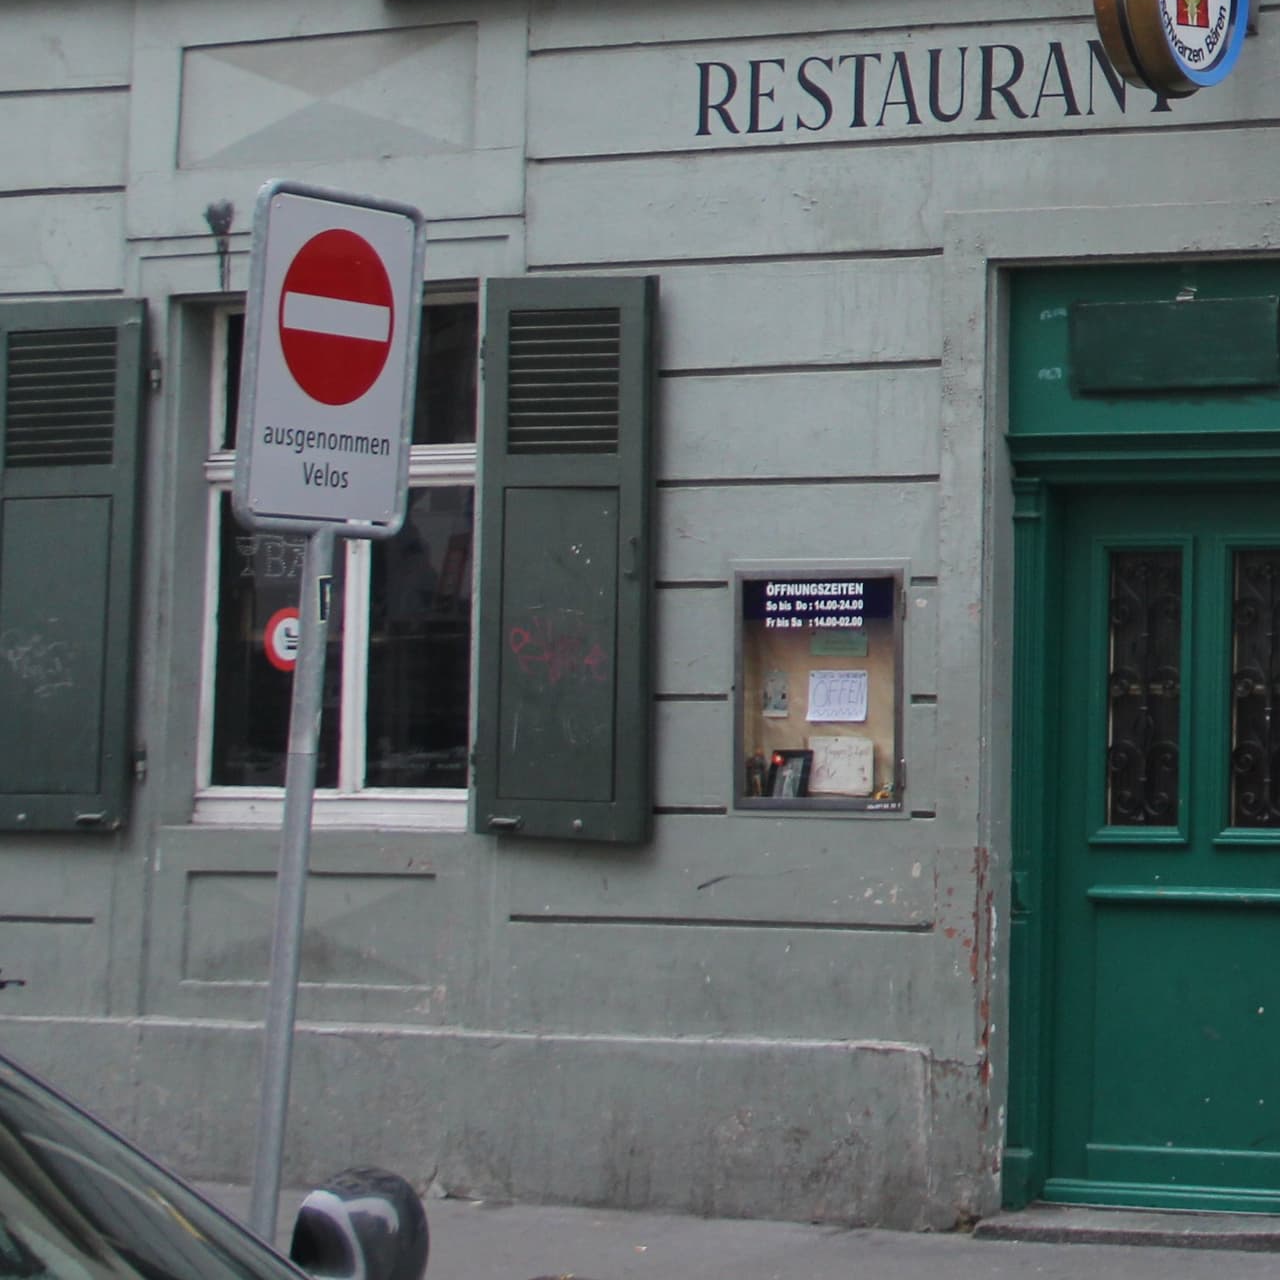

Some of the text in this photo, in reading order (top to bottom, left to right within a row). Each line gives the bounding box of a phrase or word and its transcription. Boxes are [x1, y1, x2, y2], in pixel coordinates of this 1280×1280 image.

[263, 425, 391, 456] ausgenommen
[303, 461, 349, 489] Velos
[766, 582, 864, 596] ÖFFNUNGSZEITEN
[779, 600, 792, 611] bis
